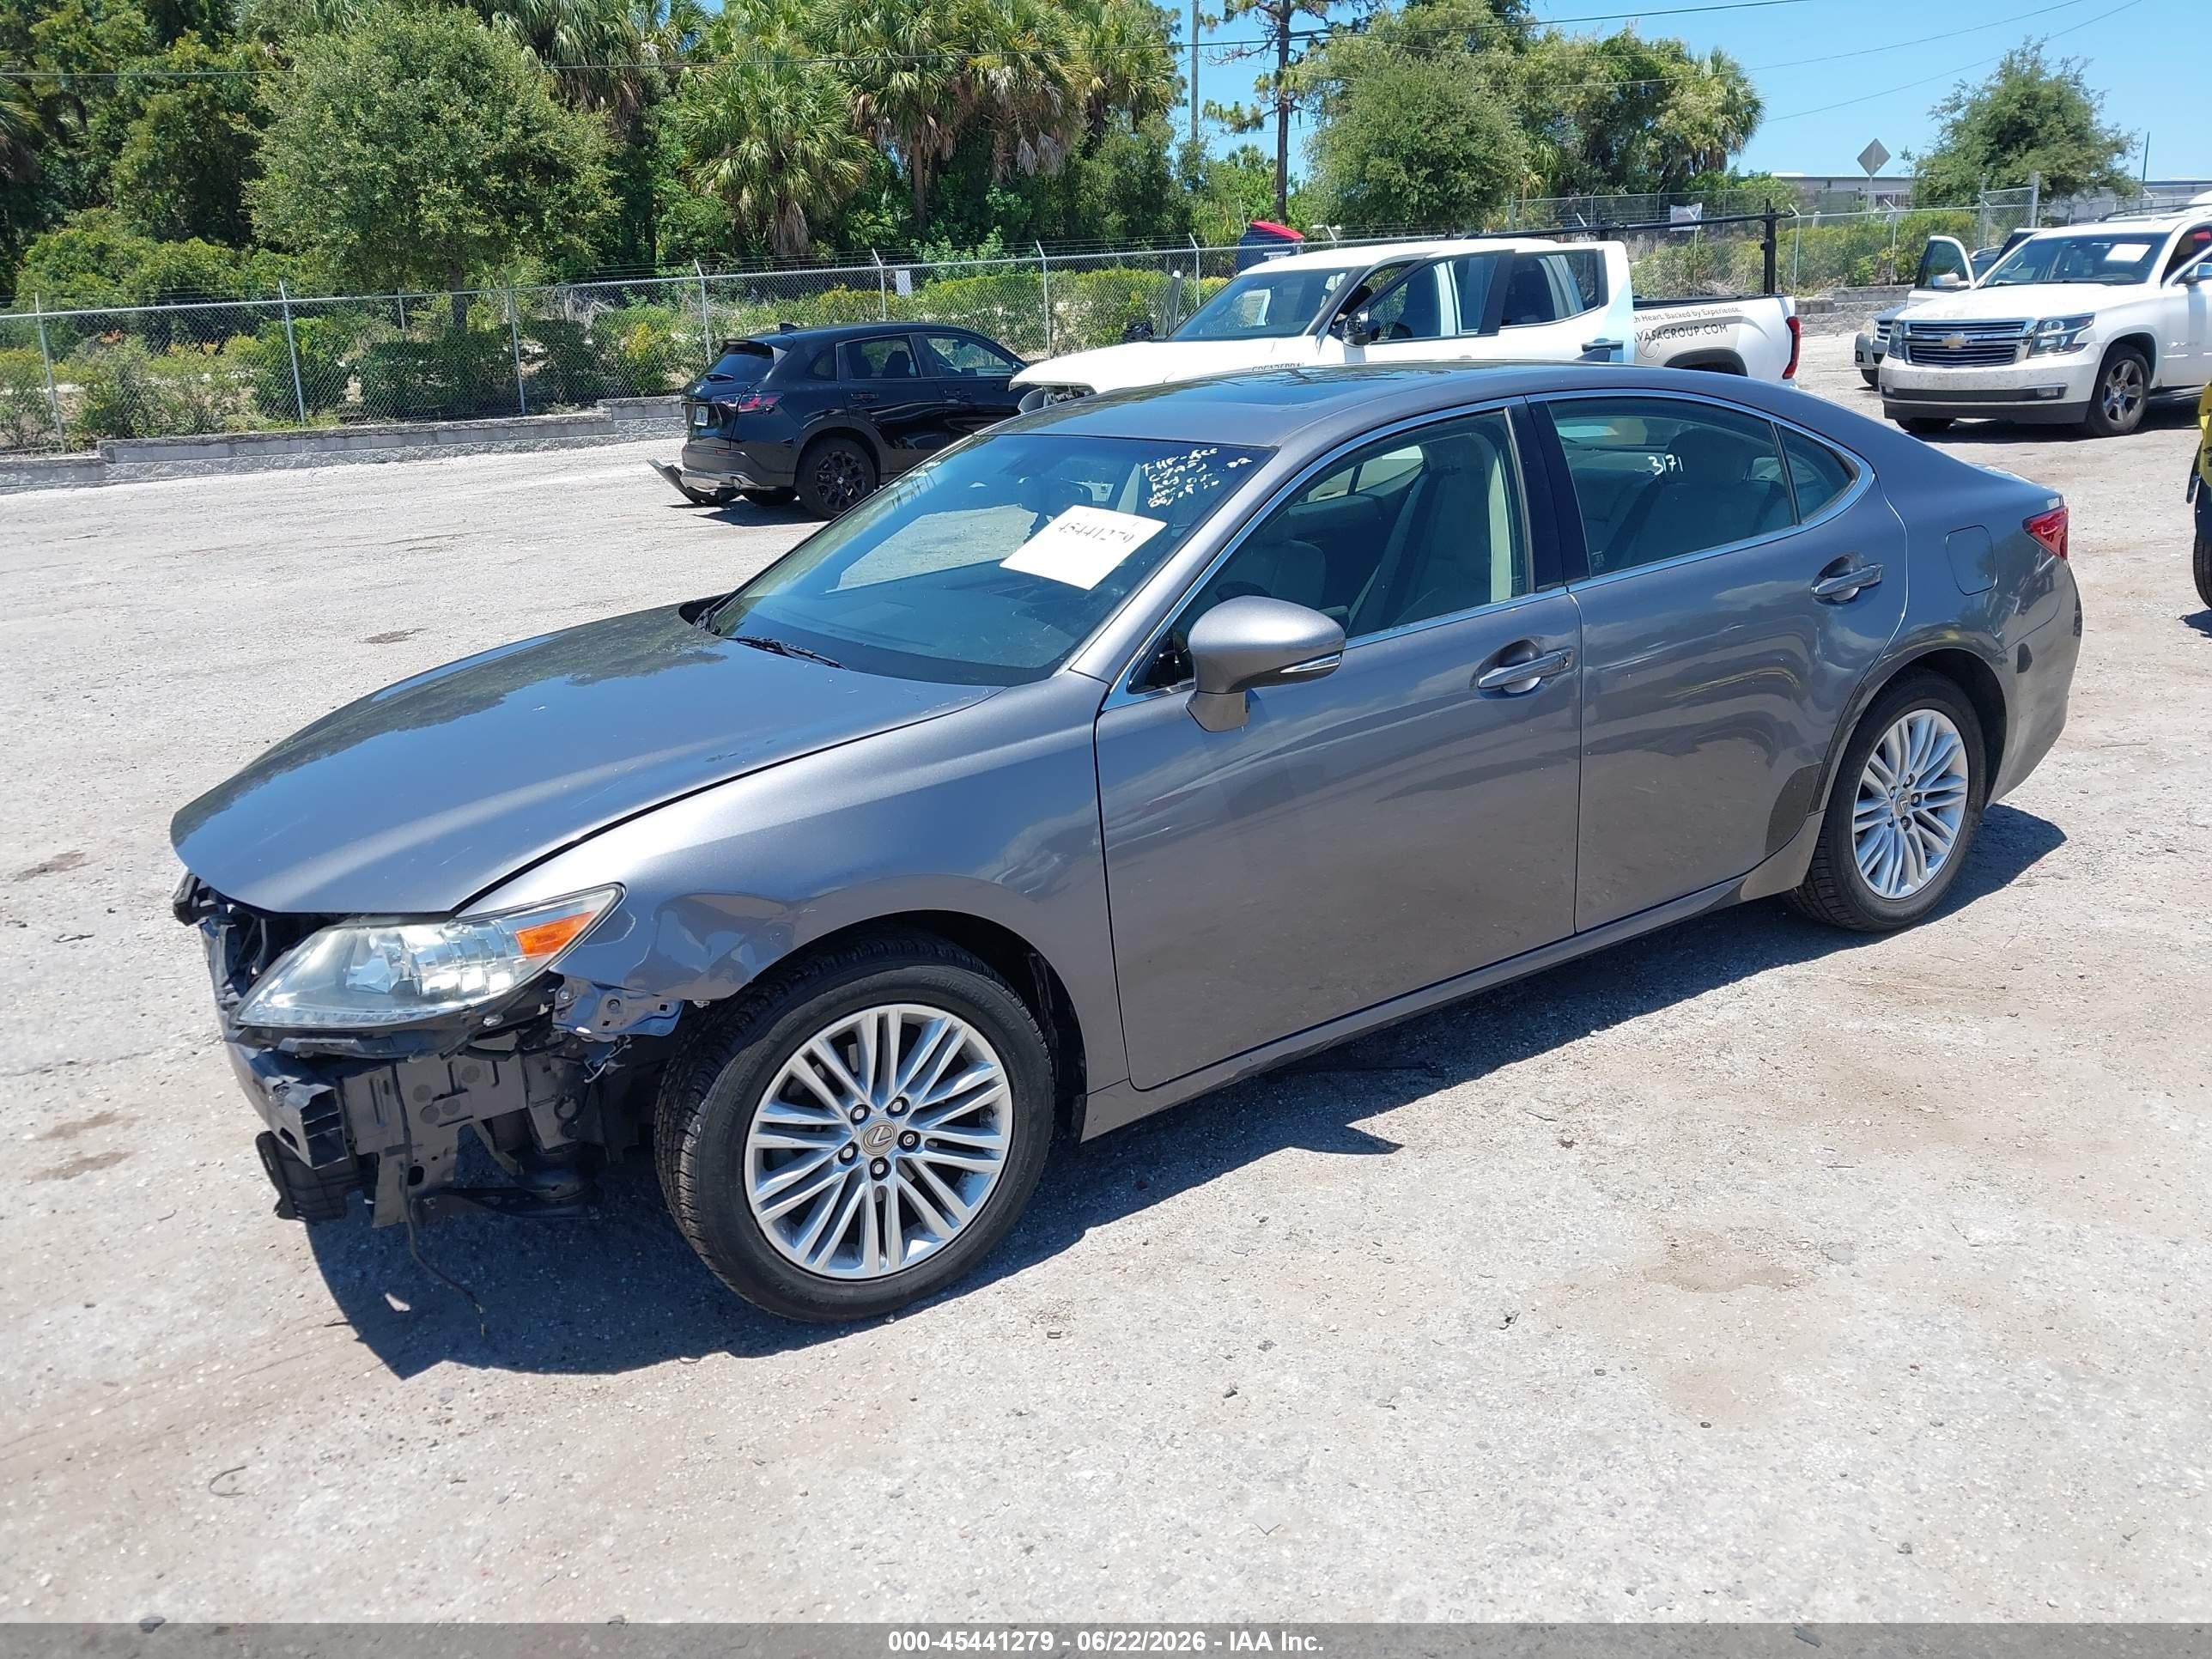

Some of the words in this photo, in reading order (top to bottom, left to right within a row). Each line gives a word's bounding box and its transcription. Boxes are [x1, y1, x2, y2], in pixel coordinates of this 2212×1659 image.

[1666, 310, 1691, 319] Backed
[1691, 309, 1701, 318] by
[1648, 454, 1684, 476] 3171
